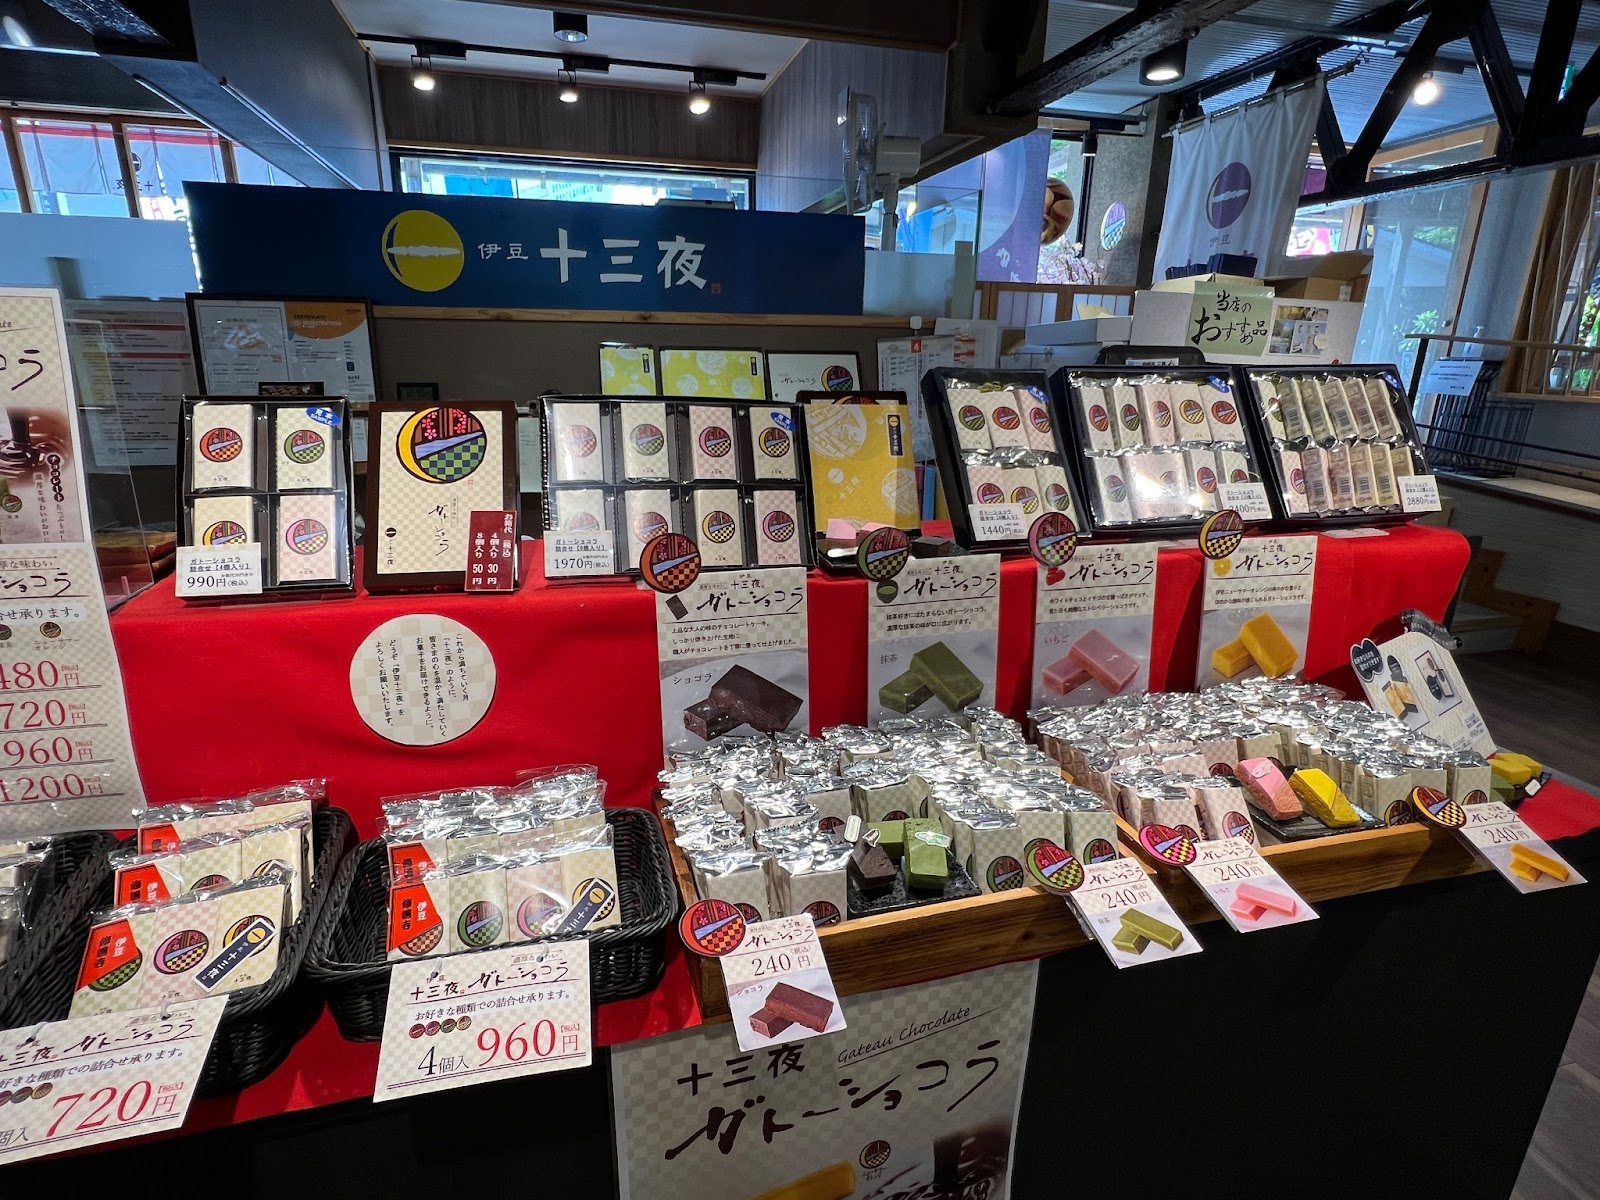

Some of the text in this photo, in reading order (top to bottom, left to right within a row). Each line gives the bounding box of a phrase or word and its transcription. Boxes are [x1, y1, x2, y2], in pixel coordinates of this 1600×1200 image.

[478, 227, 708, 290] 伊豆 十三夜
[1217, 289, 1252, 312] 当店の
[1191, 307, 1268, 345] おすすめ品
[1098, 553, 1122, 563] 十三夜
[1262, 544, 1284, 553] 十三夜
[934, 566, 961, 575] 十三夜
[1069, 561, 1154, 582] ガトーショコラ
[1235, 553, 1313, 573] ガトーショコラ
[731, 579, 761, 589] 十三夜
[904, 573, 997, 596] ガトーショコラ
[697, 587, 803, 612] ガトーショコラ
[673, 674, 712, 685] ショコラ
[1090, 867, 1144, 885] ガトーショコラ
[745, 926, 814, 947] ガトーショコラ
[410, 962, 569, 1001] 十三夜 ガトーショコラ
[414, 990, 570, 1021] お好きな種類での詰合せ承ります。
[64, 1018, 195, 1053] ガトーショコラ
[838, 1007, 970, 1063] Gateau Chocolate
[417, 1045, 469, 1076] 4個入
[677, 1043, 805, 1096] 十三夜
[664, 1040, 1001, 1160] ガトーショコラ
